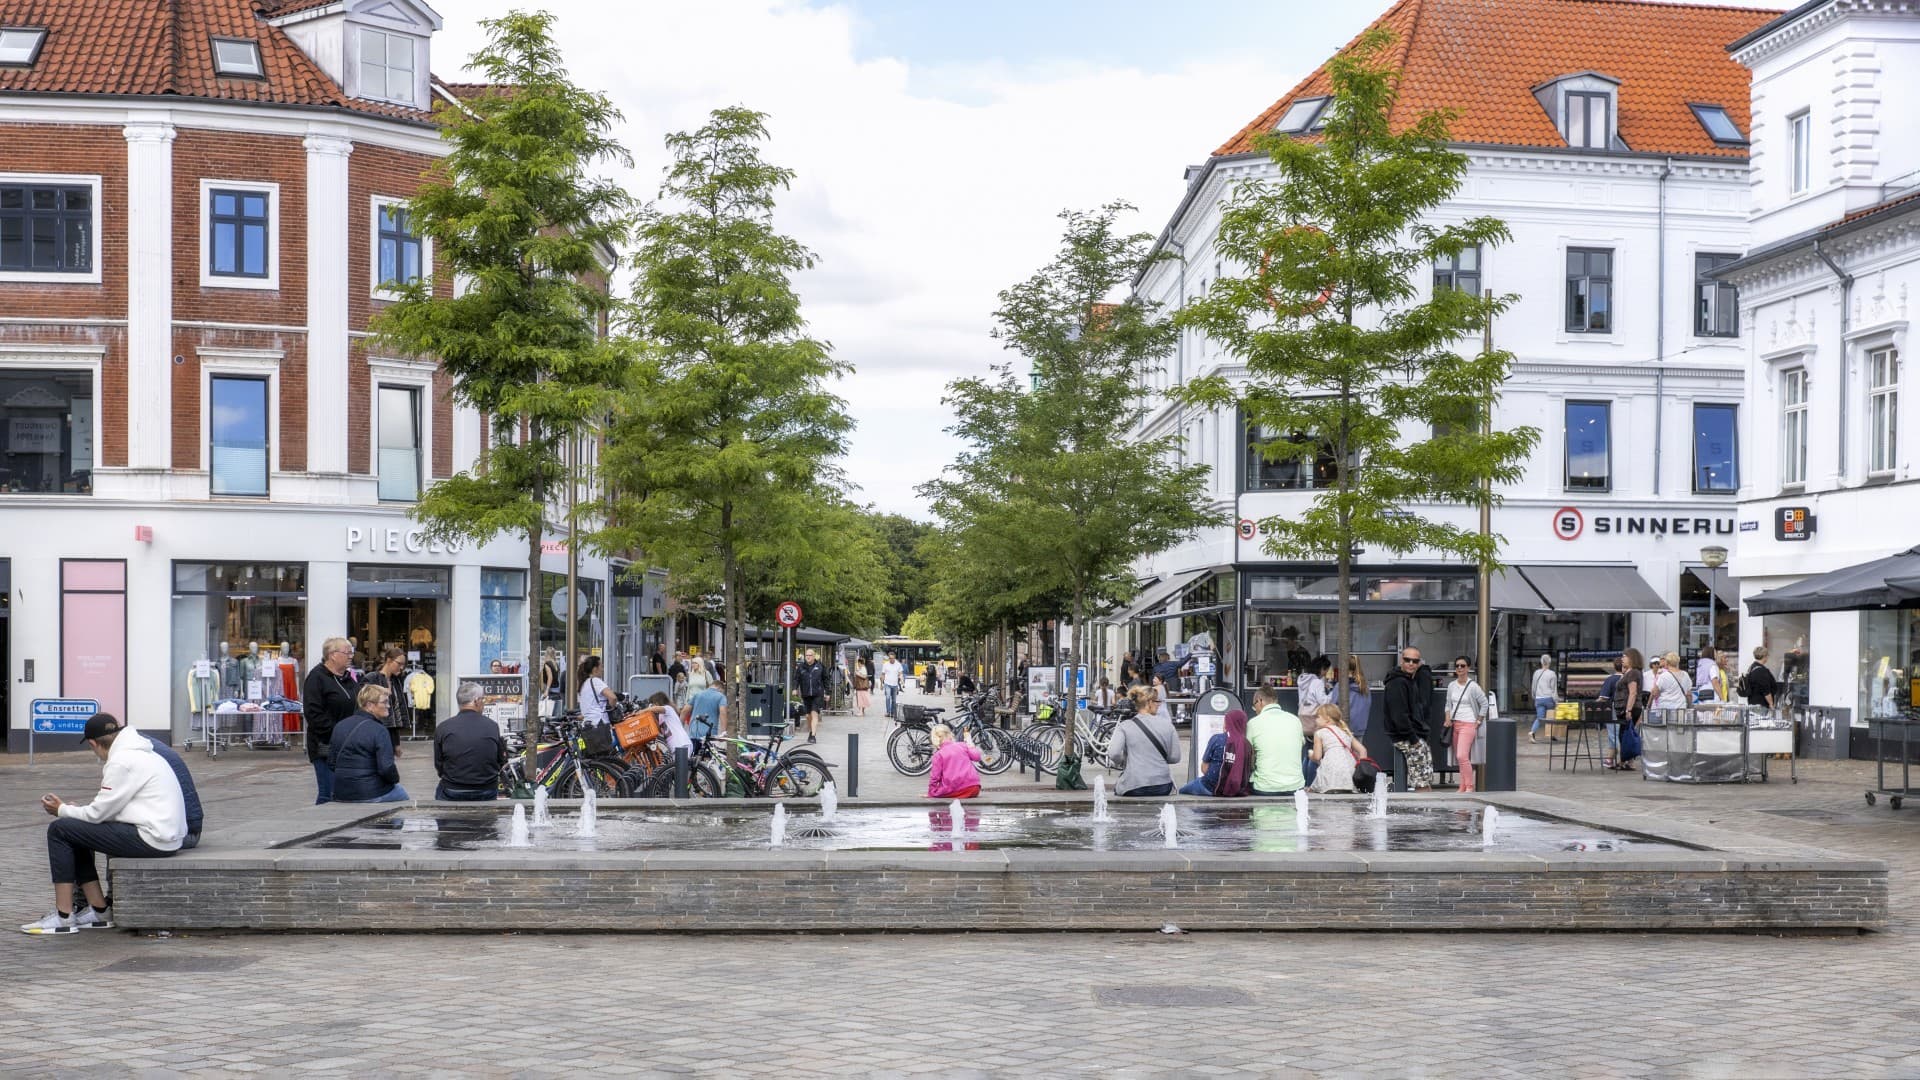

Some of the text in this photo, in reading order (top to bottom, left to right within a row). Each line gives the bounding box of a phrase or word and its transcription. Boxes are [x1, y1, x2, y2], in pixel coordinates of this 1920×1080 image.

[1561, 517, 1576, 531] S
[1594, 517, 1734, 535] SINNERU
[1242, 525, 1252, 534] S
[496, 685, 520, 694] HAO
[48, 704, 89, 712] Ensrettet
[58, 722, 84, 730] undtag
